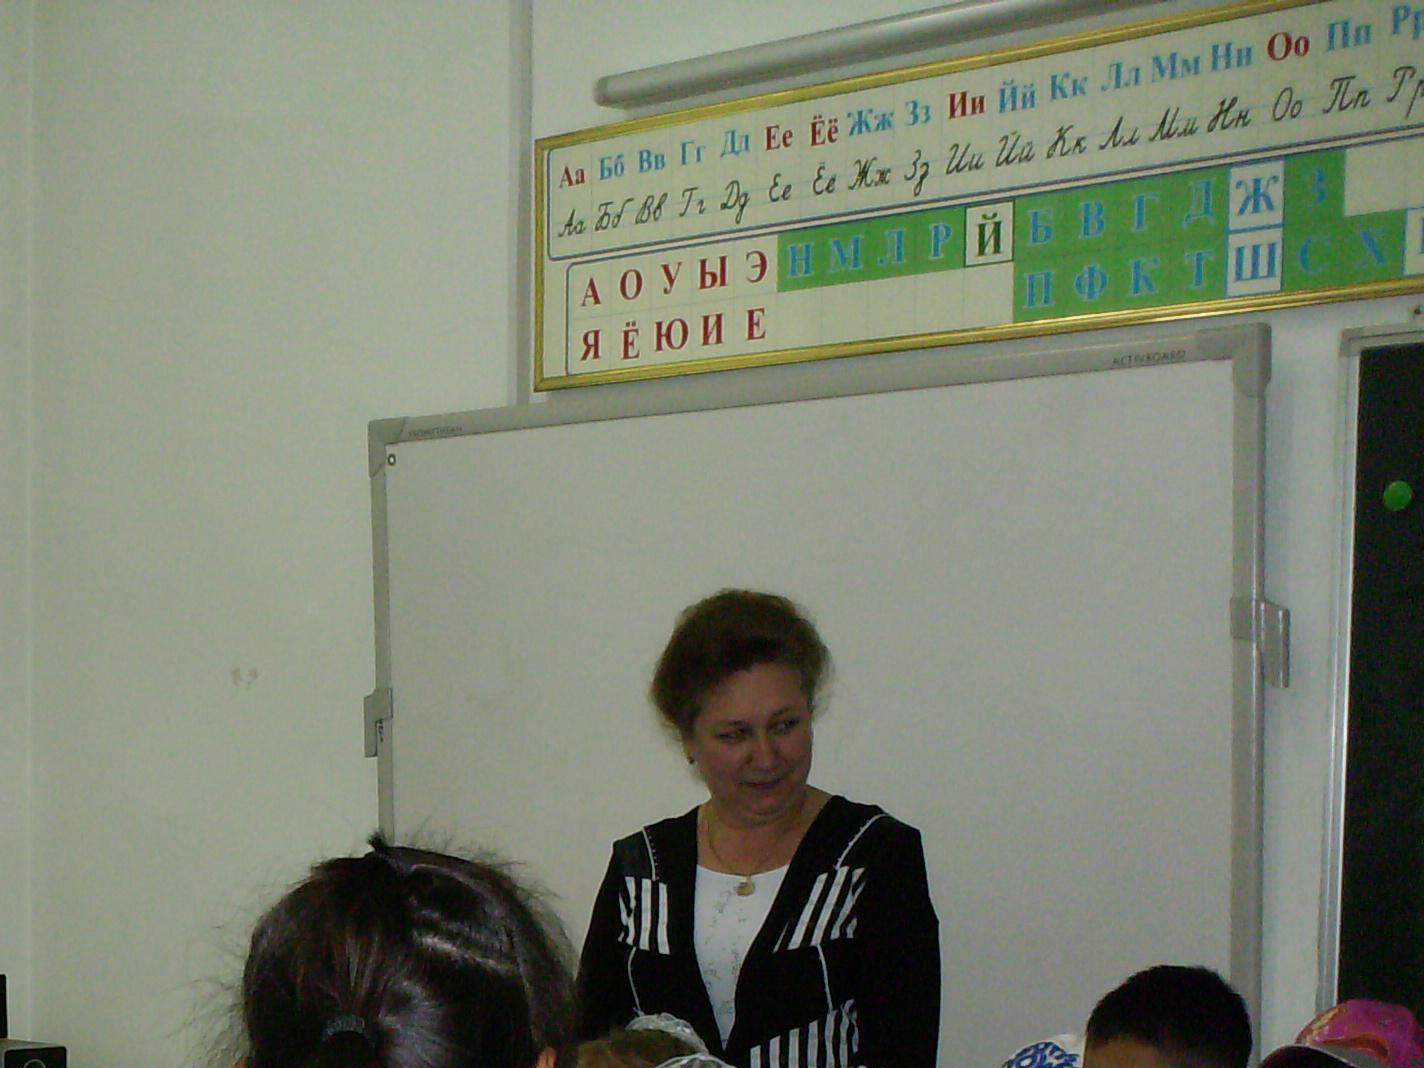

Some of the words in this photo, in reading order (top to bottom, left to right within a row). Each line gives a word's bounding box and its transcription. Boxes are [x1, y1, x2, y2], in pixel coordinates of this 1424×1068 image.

[558, 209, 586, 237] Аа
[595, 198, 634, 231] Бб
[635, 193, 668, 224] Вв
[679, 187, 706, 217] Гг
[720, 180, 750, 224] Дд
[769, 173, 791, 202] Ее
[848, 159, 891, 190] Жж
[904, 150, 929, 197] Зз
[946, 144, 984, 175] Ии
[1047, 125, 1086, 159] Кк
[1099, 116, 1140, 150] Лл
[1149, 107, 1198, 142] Мм
[1208, 97, 1251, 132] Нн
[1273, 87, 1302, 122] Оо
[1323, 76, 1371, 114] Пп
[560, 166, 585, 188] Аа
[599, 154, 624, 181] Бб
[639, 149, 665, 172] Вв
[682, 140, 706, 165] Гг
[720, 130, 749, 157] Дд
[766, 125, 792, 150] Ее
[811, 115, 838, 146] Ёё
[847, 109, 894, 136] Жж
[906, 100, 930, 126] Зз
[949, 91, 984, 119] Ии
[1000, 80, 1035, 113] Йй
[1051, 72, 1087, 100] Кк
[1101, 63, 1140, 91] Лл
[1152, 54, 1200, 82] Мм
[1212, 42, 1253, 72] Нн
[1267, 32, 1309, 60] Оо
[1328, 20, 1371, 50] Пп
[581, 277, 601, 306] А
[620, 270, 642, 300] О
[662, 262, 681, 294] У
[699, 256, 726, 289] Ы
[746, 251, 767, 283] Э
[787, 243, 813, 278] Н
[830, 235, 863, 272] М
[878, 228, 905, 266] Л
[928, 223, 953, 259] Р
[978, 213, 1001, 256] Й
[1029, 209, 1053, 245] Б
[1080, 201, 1104, 238] В
[1134, 192, 1159, 231] Г
[1183, 179, 1215, 227] Д
[1236, 176, 1279, 216] Ж
[1305, 168, 1328, 207] З
[581, 330, 600, 360] Я
[623, 321, 639, 360] Ё
[656, 319, 688, 351] Ю
[702, 314, 722, 346] И
[748, 308, 765, 340] Е
[1023, 271, 1055, 308] П
[1075, 264, 1108, 301] Ф
[1131, 258, 1159, 296] К
[1185, 250, 1211, 288] Т
[1235, 243, 1277, 282] Ш
[1298, 237, 1329, 274] С
[1357, 226, 1387, 268] Х
